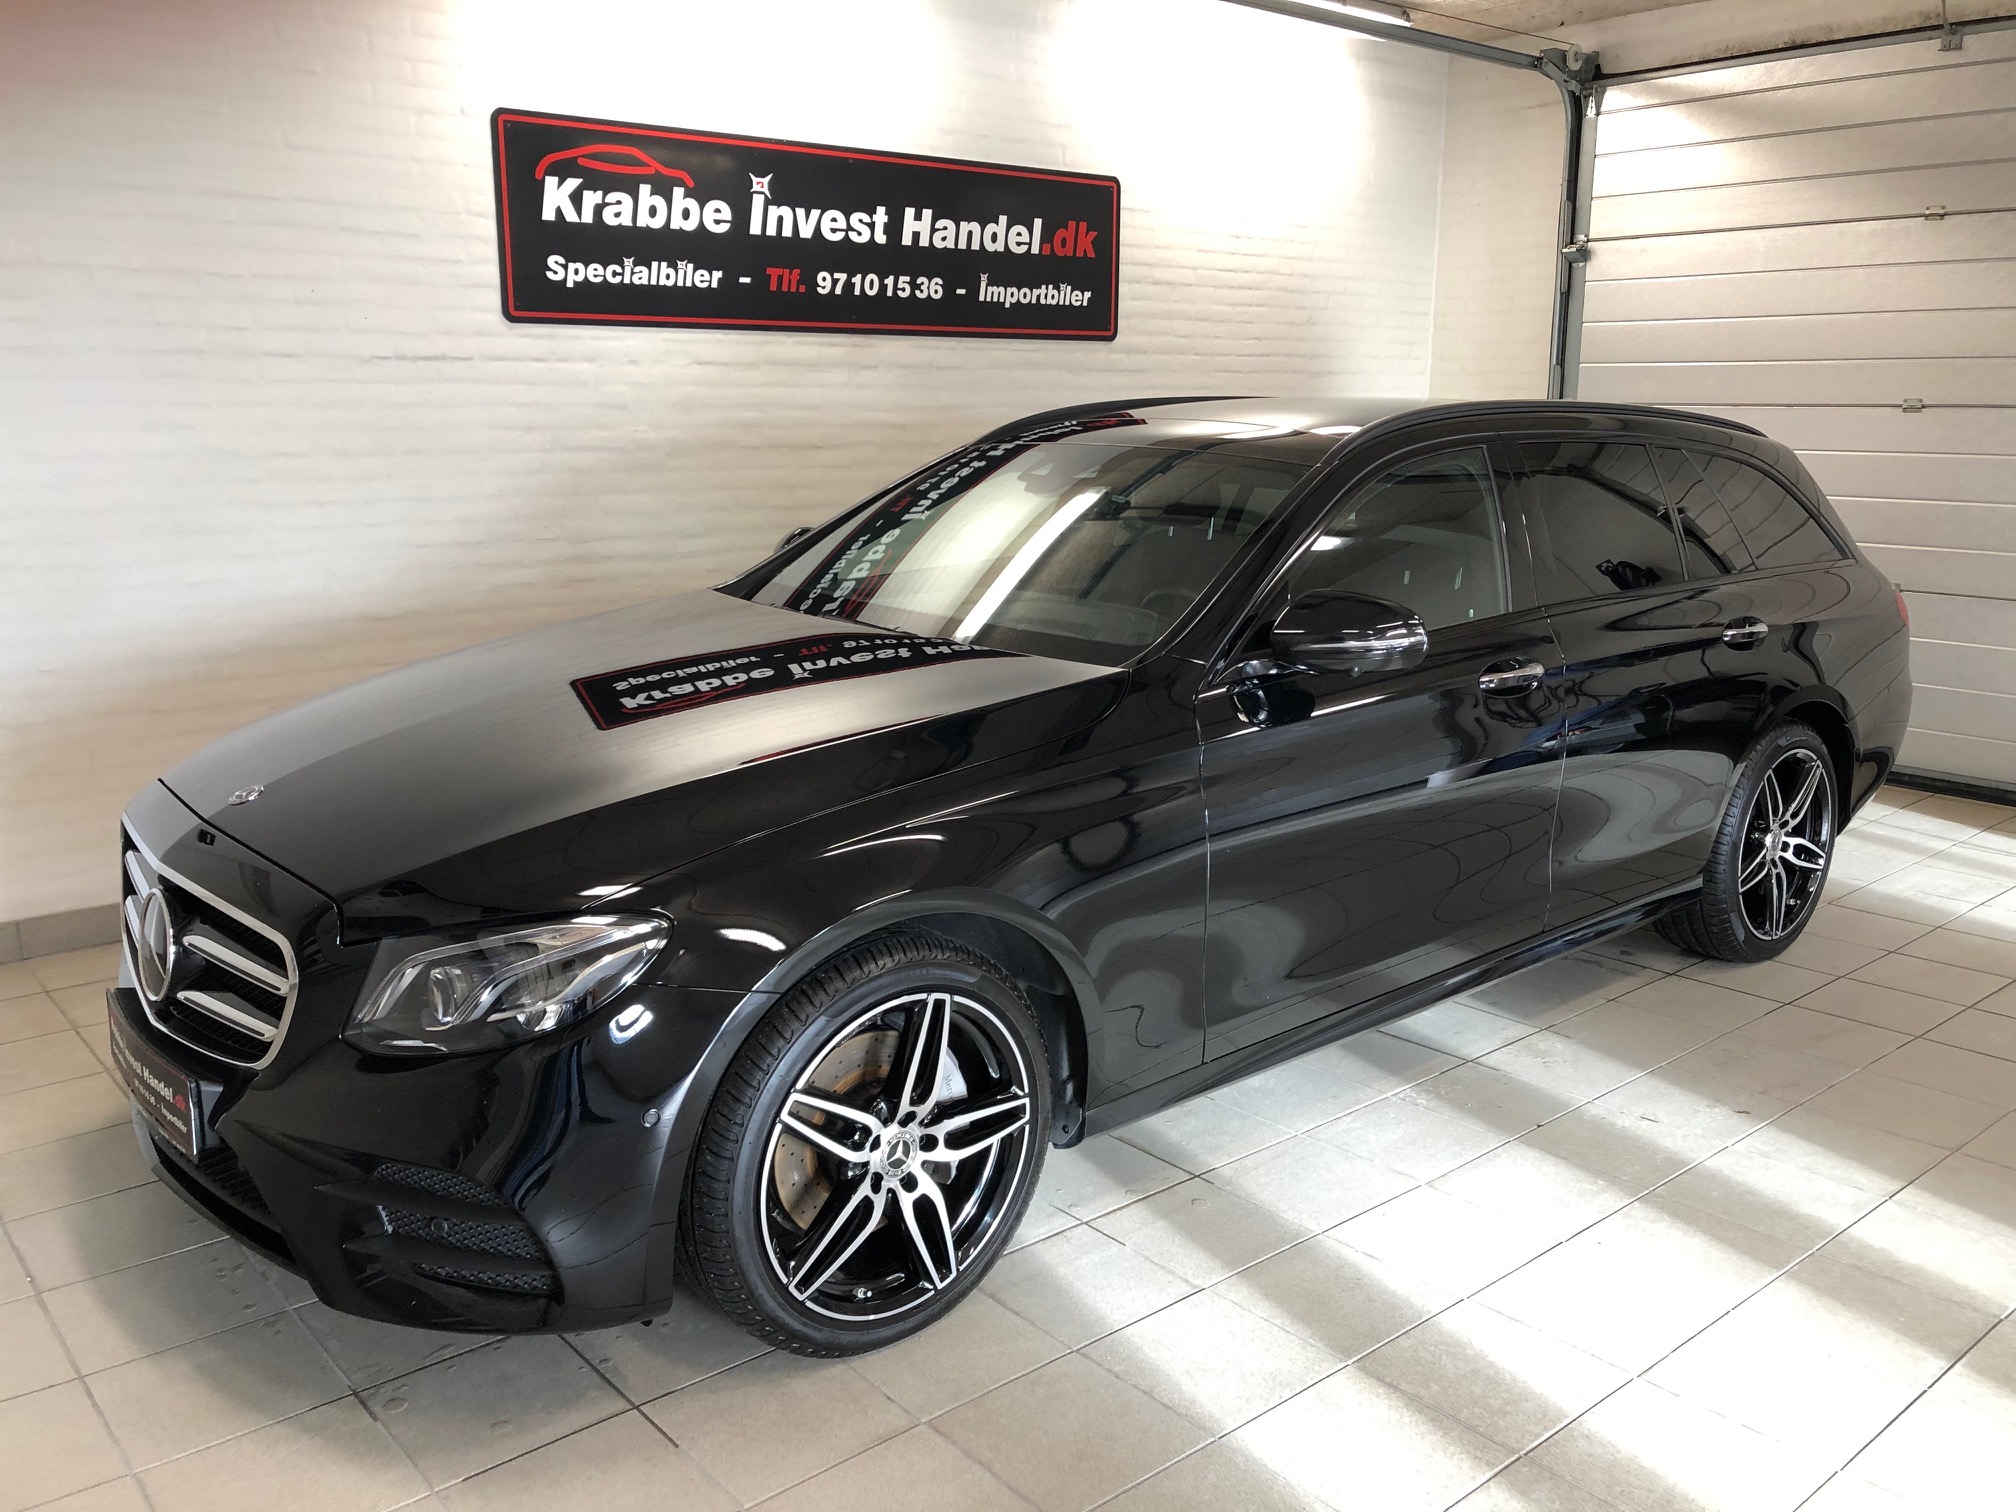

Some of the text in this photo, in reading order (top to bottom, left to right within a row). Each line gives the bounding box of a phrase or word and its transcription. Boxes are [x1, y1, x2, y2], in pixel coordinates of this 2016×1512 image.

[542, 172, 1098, 258] Krabbe Invest Handel.dk
[545, 254, 723, 288] Specialbiler
[765, 267, 806, 293] Tlf.
[978, 272, 1092, 309] Importbiler
